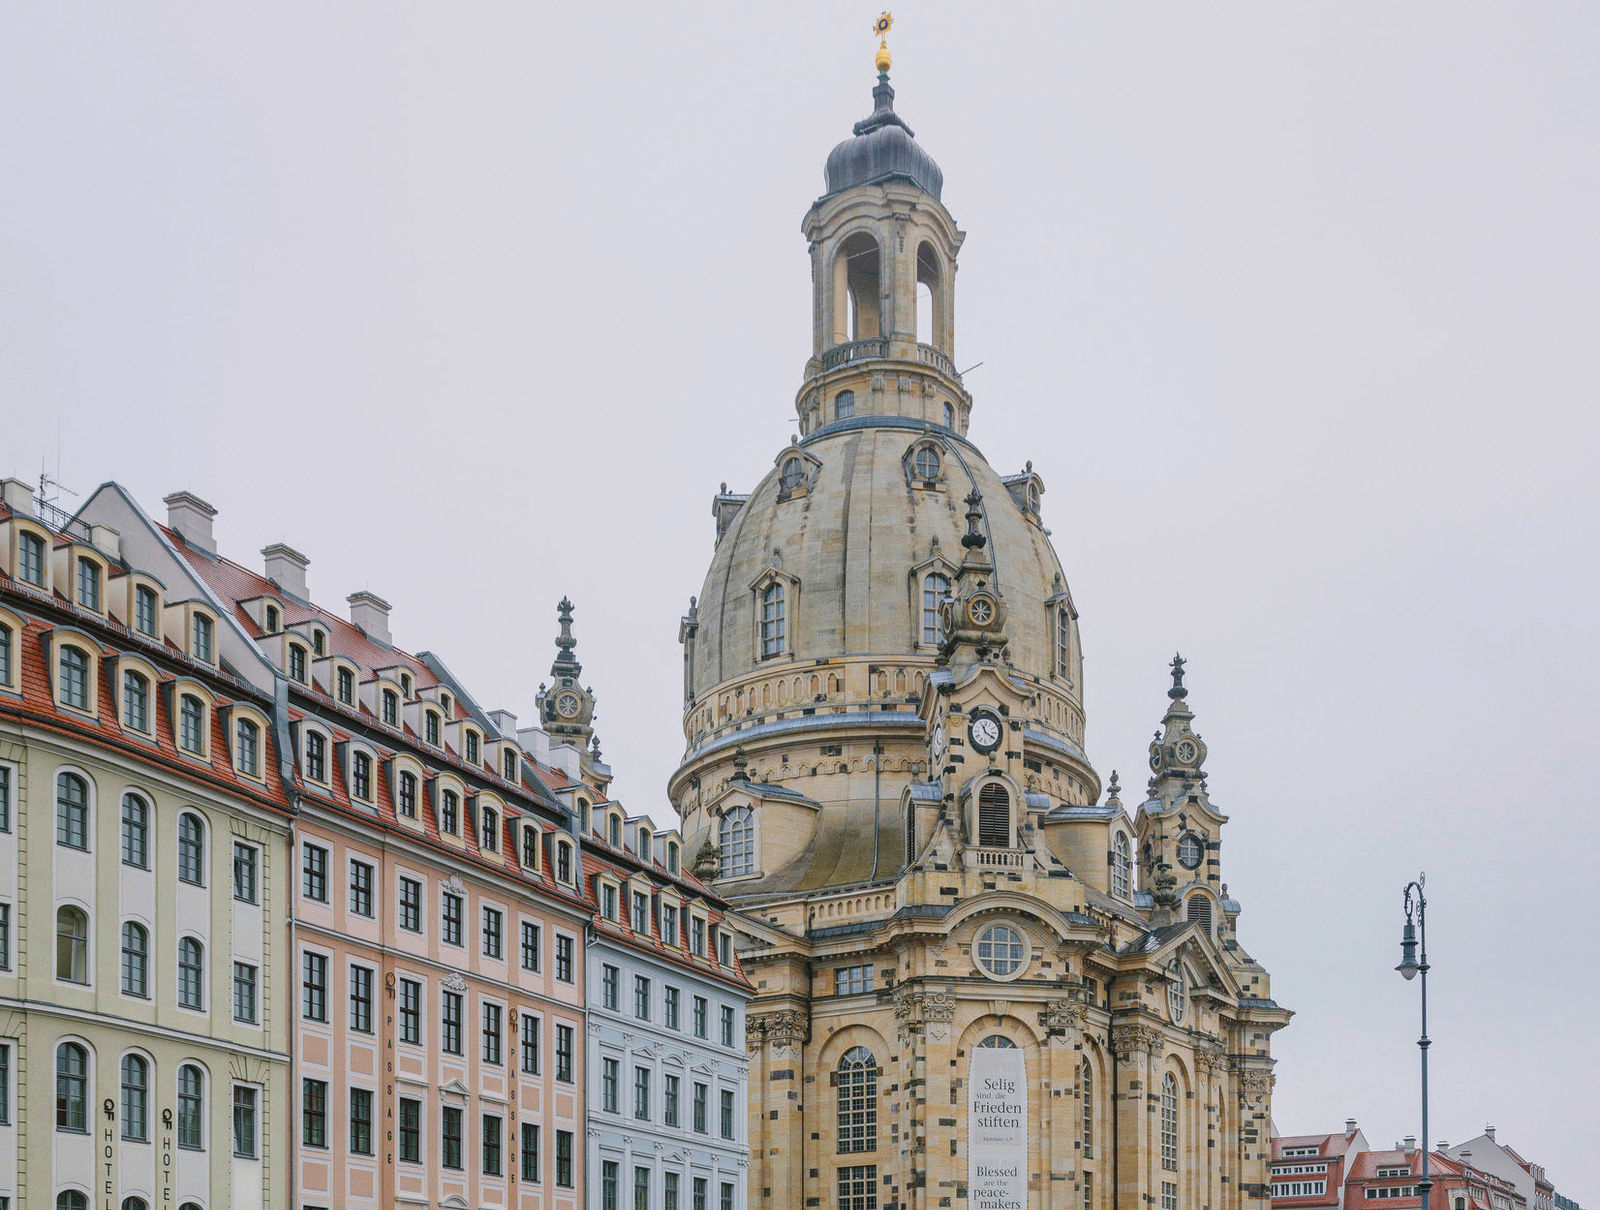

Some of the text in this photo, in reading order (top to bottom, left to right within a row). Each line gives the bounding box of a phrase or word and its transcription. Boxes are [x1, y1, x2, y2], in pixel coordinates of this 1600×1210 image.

[984, 1078, 1015, 1094] Selig
[995, 1092, 1006, 1100] die
[973, 1101, 1022, 1114] Frieden
[976, 1166, 1018, 1177] Blessed
[973, 1188, 1010, 1200] peace-
[980, 1198, 1021, 1209] makers
